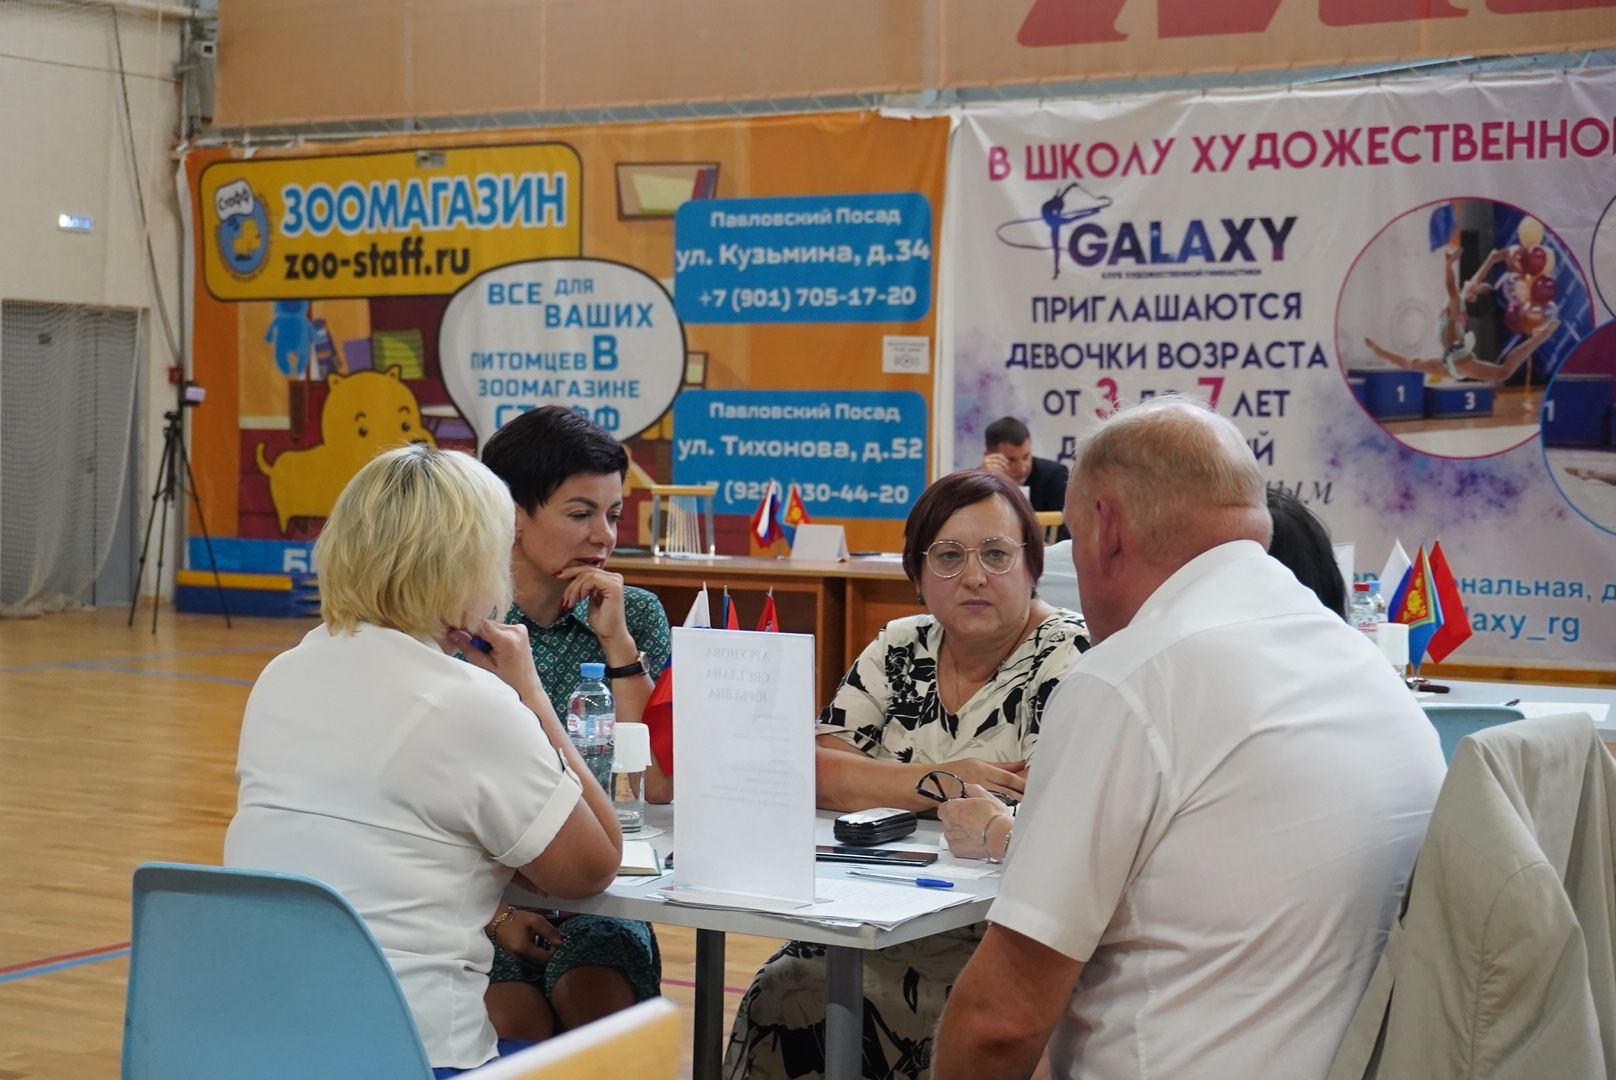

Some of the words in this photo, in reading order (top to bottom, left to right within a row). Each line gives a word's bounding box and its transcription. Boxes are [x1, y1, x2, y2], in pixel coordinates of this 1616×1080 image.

[988, 147, 1011, 182] В
[1025, 137, 1175, 181] ШКОЛУ
[1192, 116, 1616, 175] ХУДОЖЕСТВЕННО
[281, 172, 567, 236] ЗООМАГАЗИН
[711, 209, 832, 228] Павловский
[835, 208, 901, 226] Посад
[676, 248, 713, 272] ул.
[719, 244, 862, 272] Кузьмина,
[866, 238, 932, 266] д.34
[1068, 215, 1299, 268] GALAXY
[284, 236, 470, 280] zoo-staff.ru
[488, 283, 542, 305] ВСЕ
[699, 290, 728, 308] +7
[732, 287, 791, 312] (901)
[796, 286, 917, 308] 705-17-20
[1031, 292, 1302, 323] ПРИГЛАШАЮТСЯ
[544, 303, 655, 329] ВАШИХ
[470, 351, 587, 372] ПИТОМЦЕВ
[593, 335, 618, 371] В
[1005, 343, 1147, 369] ДЕВОЧКИ
[1157, 341, 1329, 369] ВОЗРАСТА
[478, 379, 640, 399] ЗООМАГАЗИНЕ
[1043, 390, 1081, 416] ОТ
[1096, 378, 1118, 419] 3
[1197, 377, 1225, 411] 7
[1232, 390, 1290, 417] ЛЕТ
[1397, 385, 1404, 402] 1
[1465, 392, 1475, 410] 3
[709, 402, 831, 420] Павловский
[835, 403, 901, 422] Посад
[678, 437, 715, 461] ул.
[720, 435, 857, 462] Тихонова,
[862, 437, 923, 463] д.52
[790, 482, 909, 504] 30-44-20
